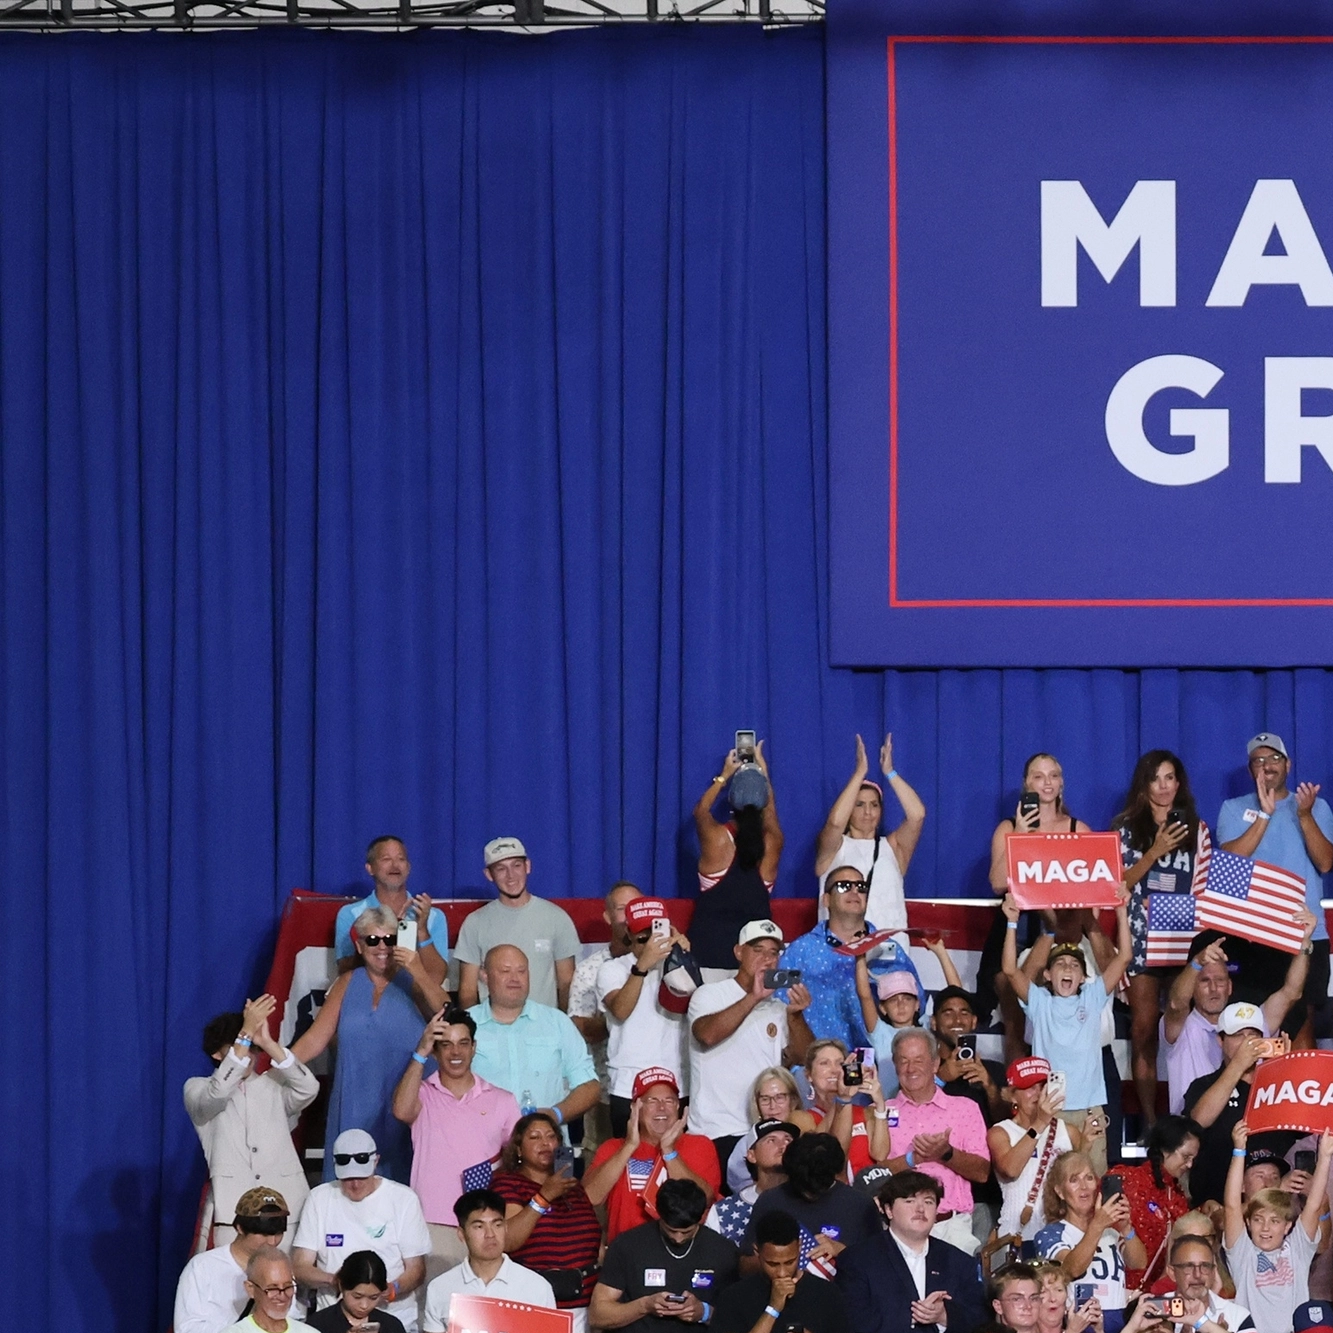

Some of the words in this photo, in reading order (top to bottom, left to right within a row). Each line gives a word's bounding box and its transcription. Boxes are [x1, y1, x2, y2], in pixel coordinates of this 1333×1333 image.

[1017, 859, 1114, 884] MAGA
[862, 1167, 893, 1185] MOM
[1091, 1244, 1126, 1282] SA
[647, 1272, 662, 1280] FRY
